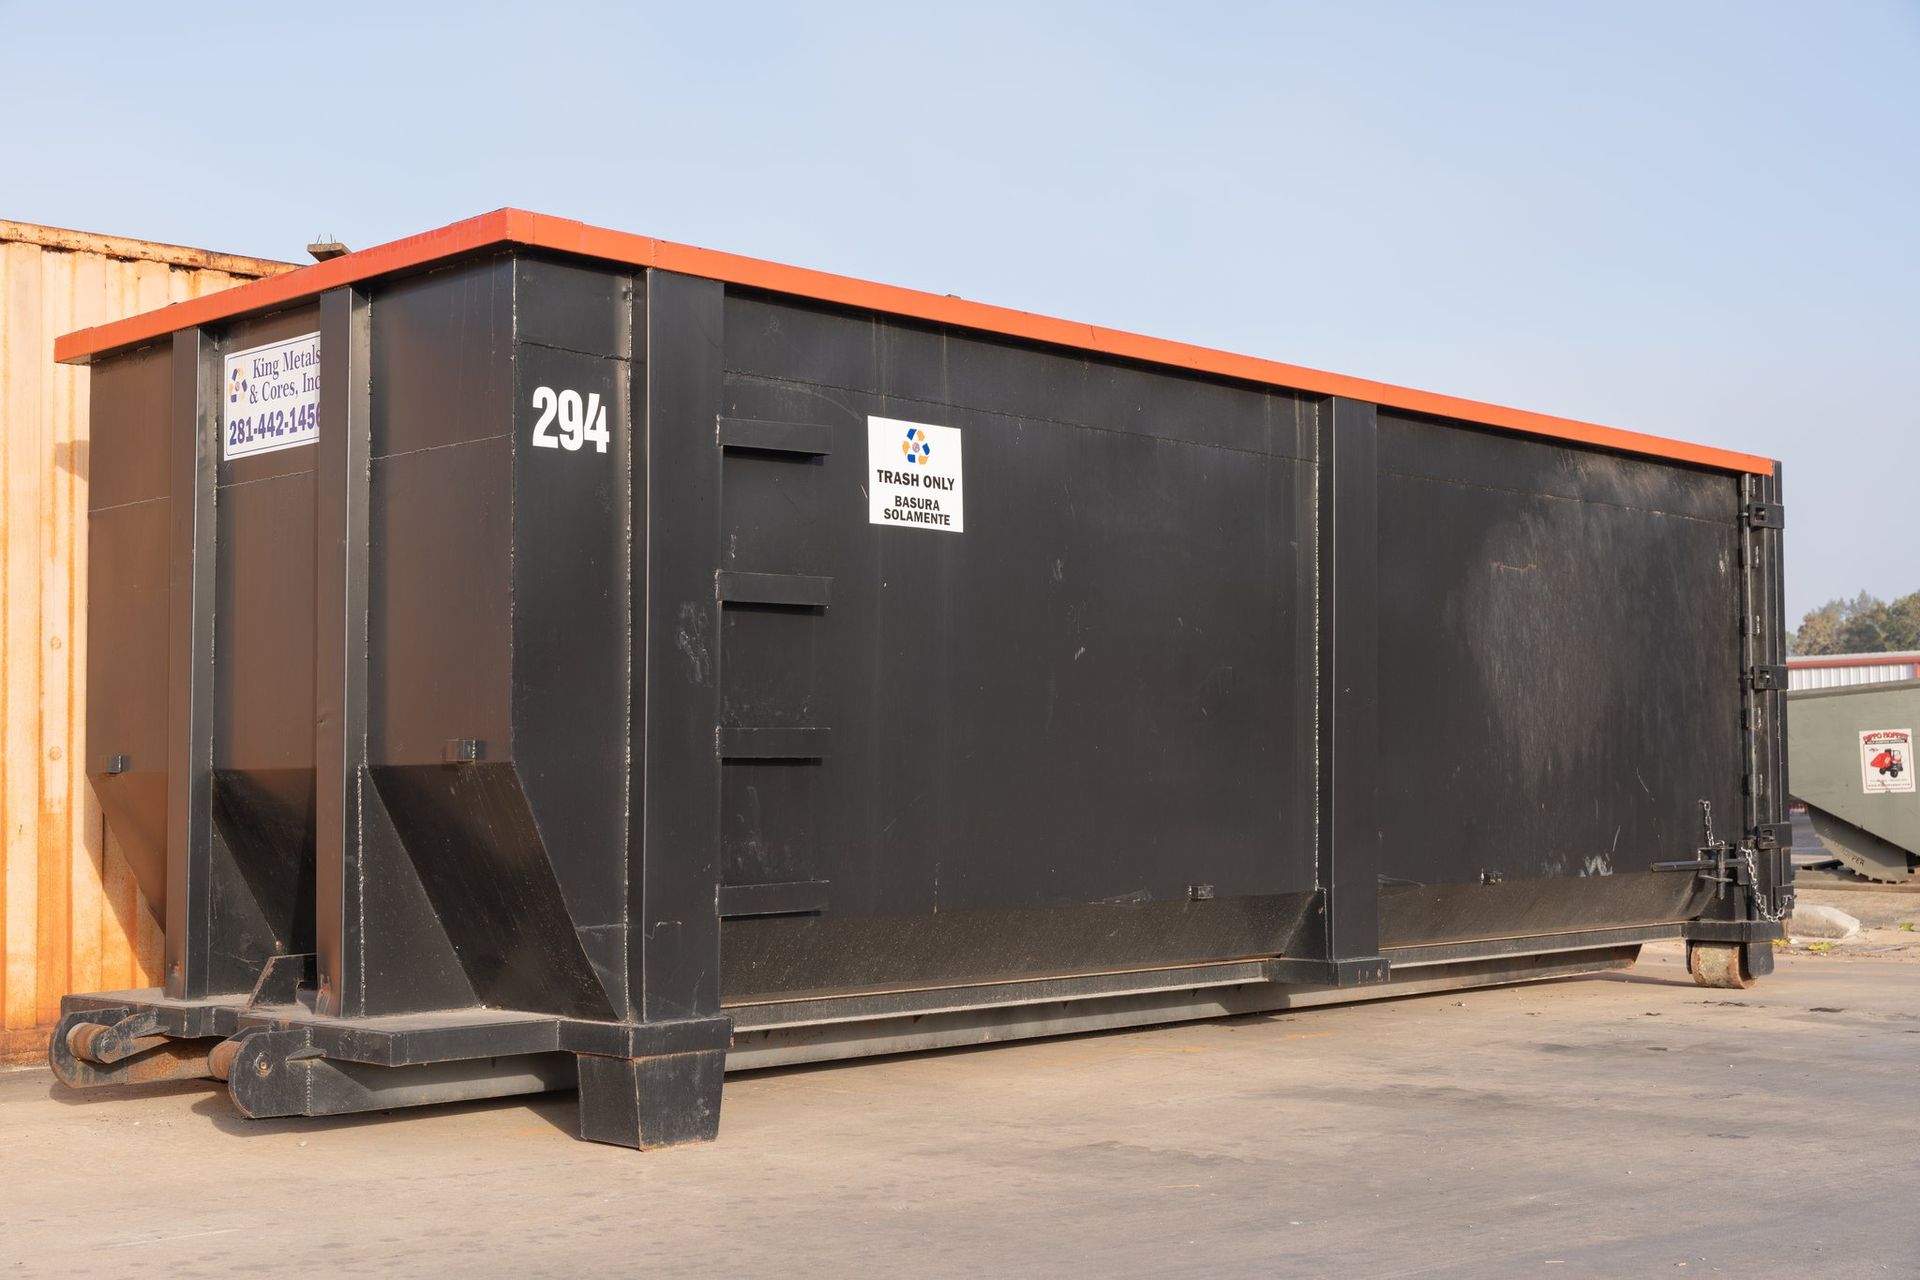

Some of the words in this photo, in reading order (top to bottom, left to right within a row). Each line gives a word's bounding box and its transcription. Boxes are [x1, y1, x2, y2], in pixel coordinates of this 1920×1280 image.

[252, 357, 280, 380] King
[283, 344, 320, 373] Metals
[249, 384, 259, 404] &
[261, 381, 299, 402] Cores,
[532, 386, 610, 454] 294
[877, 469, 920, 487] TRASH
[923, 475, 955, 491] ONLY
[895, 495, 940, 511] BASURA
[884, 508, 951, 526] SOLAMENTE
